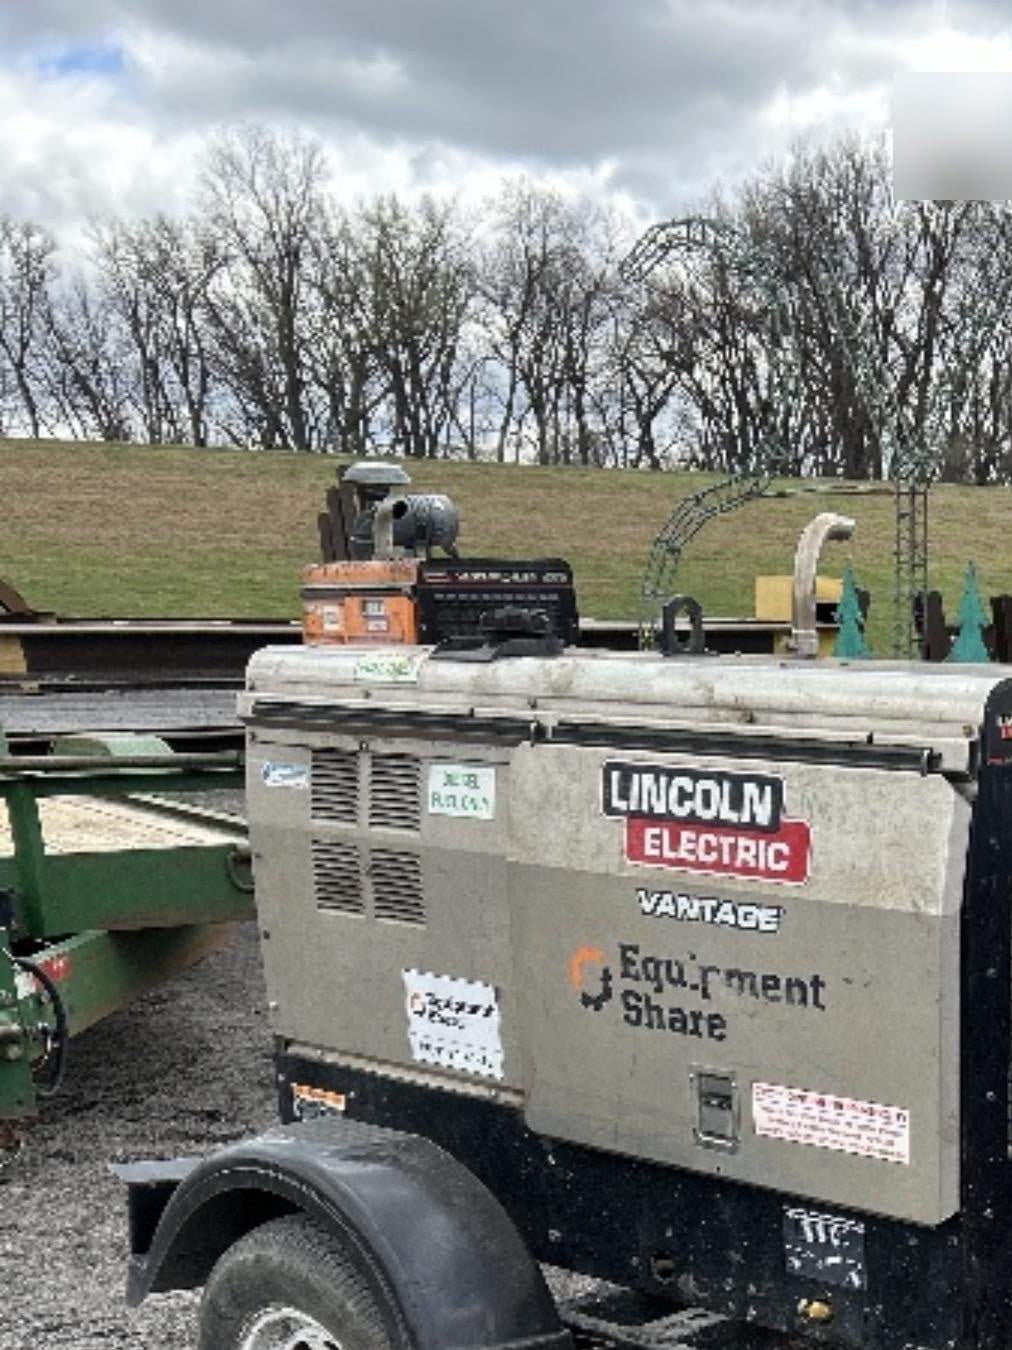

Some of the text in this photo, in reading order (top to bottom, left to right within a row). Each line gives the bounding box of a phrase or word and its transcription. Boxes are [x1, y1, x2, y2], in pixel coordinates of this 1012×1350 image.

[610, 770, 772, 827] LINCOLN
[643, 826, 791, 872] ELECTRIC
[635, 888, 784, 933] VANTAGE
[620, 989, 727, 1042] Share
